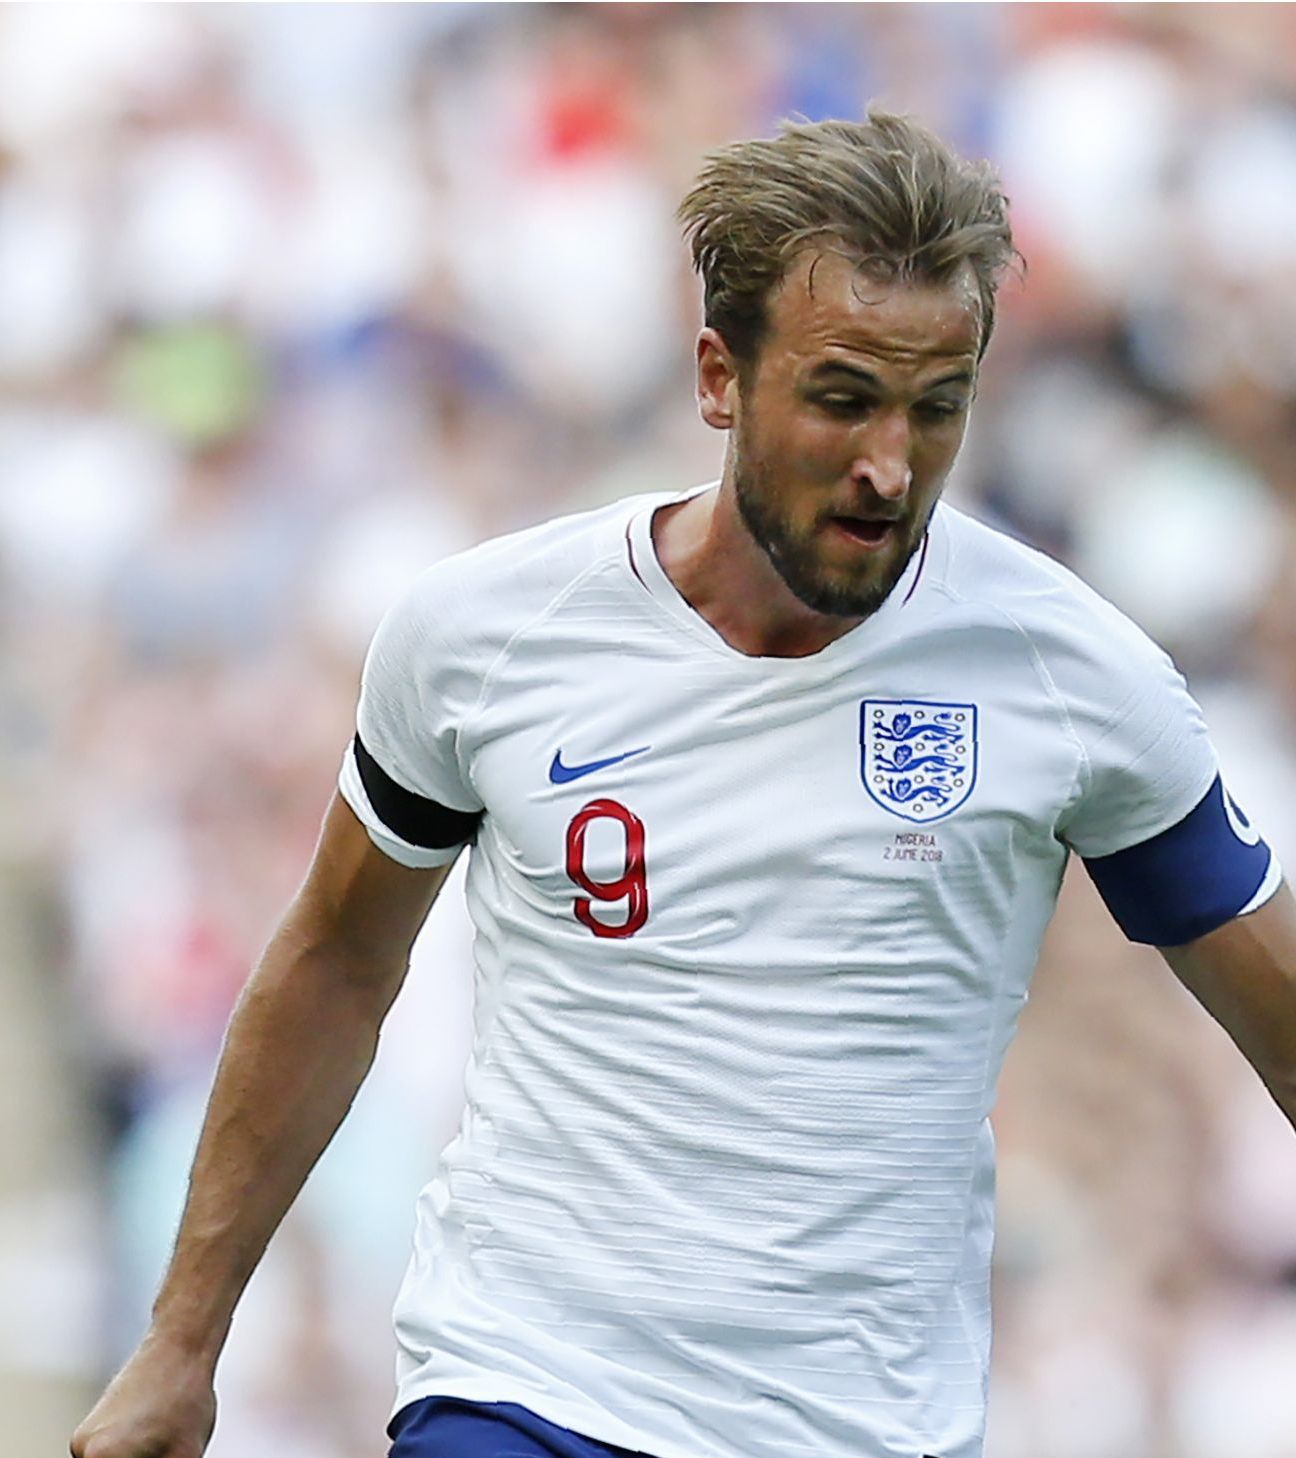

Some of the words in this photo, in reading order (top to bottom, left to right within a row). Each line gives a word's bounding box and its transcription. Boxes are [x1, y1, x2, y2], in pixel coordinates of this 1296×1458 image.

[894, 833, 936, 847] NIGERIA
[883, 846, 891, 860] 2
[566, 798, 649, 939] 9
